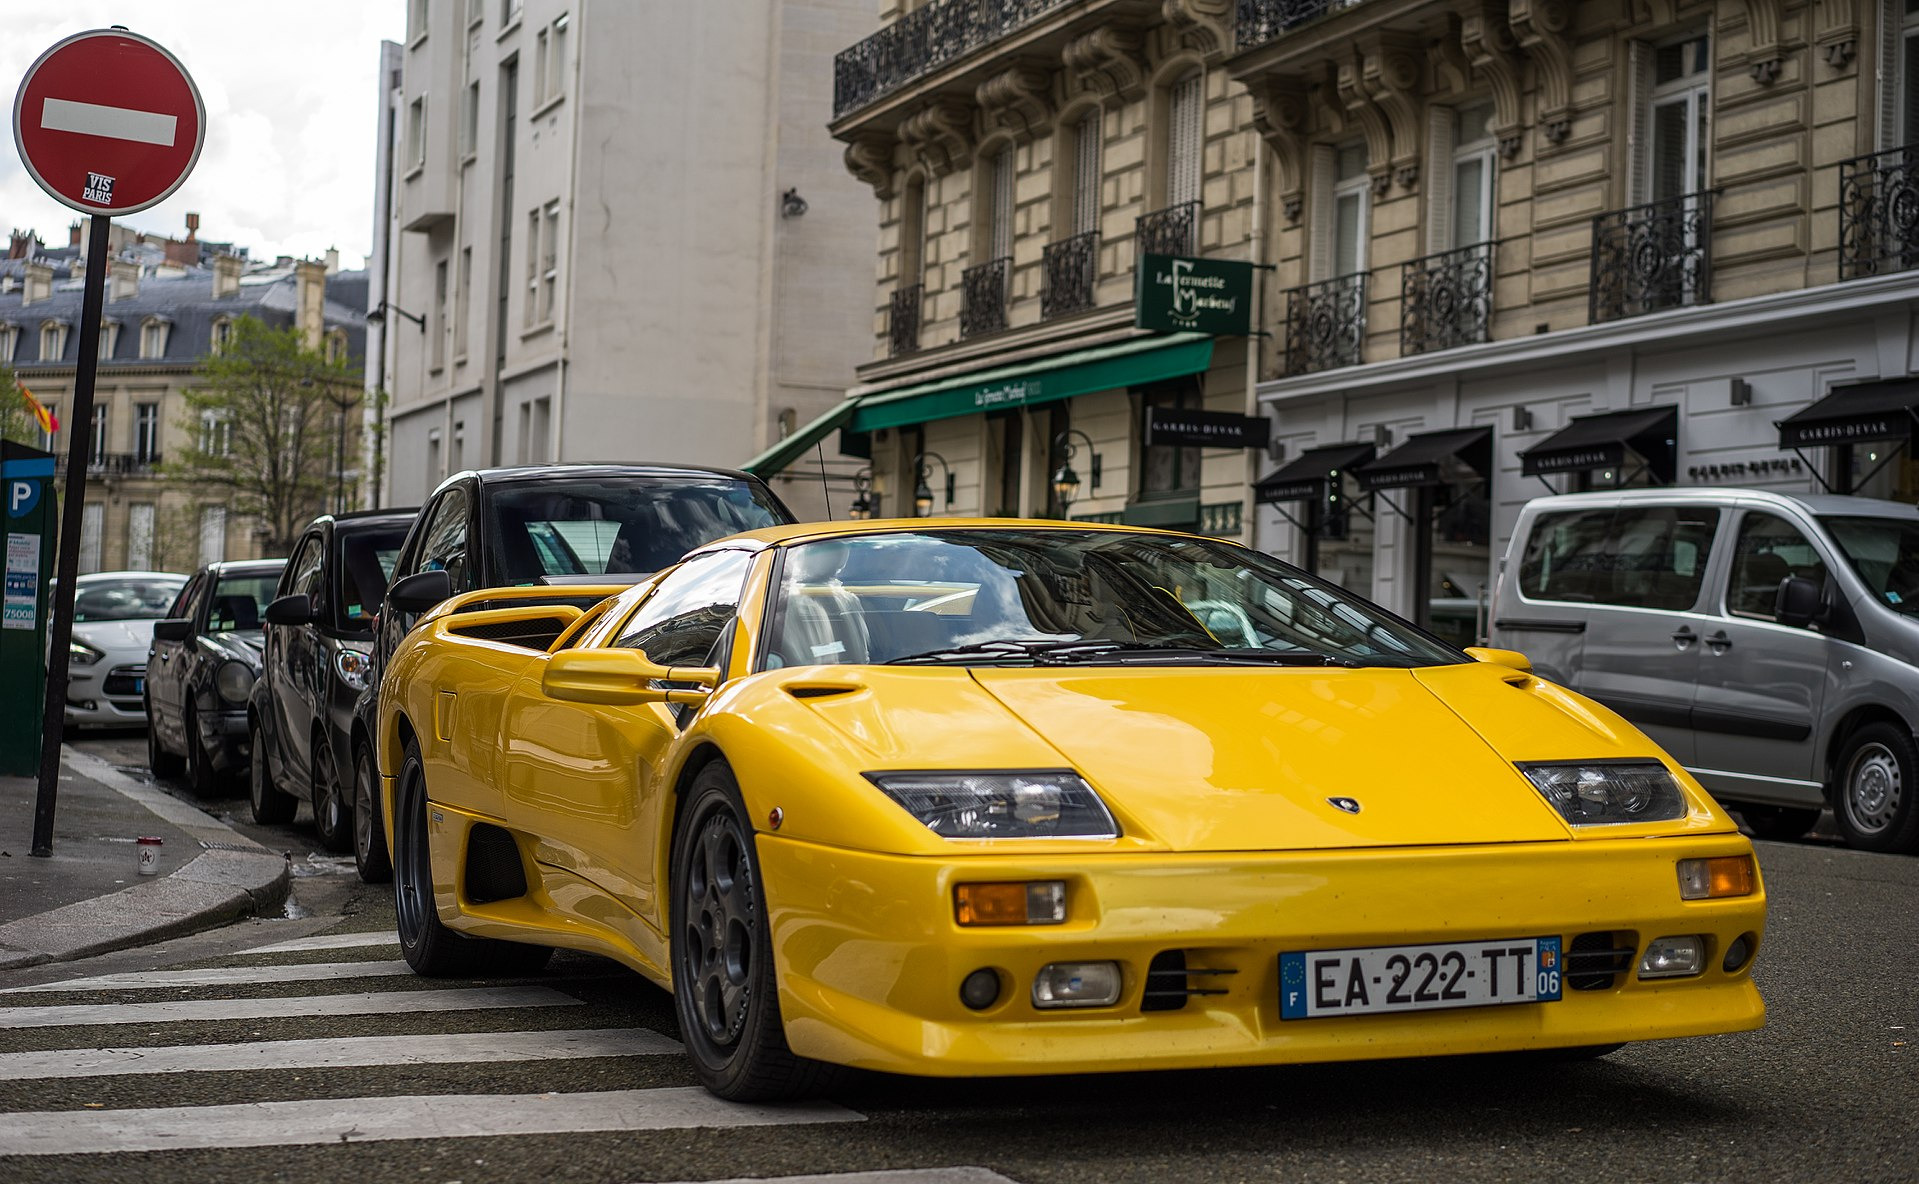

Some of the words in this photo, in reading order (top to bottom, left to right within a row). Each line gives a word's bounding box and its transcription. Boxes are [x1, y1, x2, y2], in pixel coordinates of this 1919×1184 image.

[90, 175, 111, 191] VIS
[83, 187, 112, 203] PARIS
[1156, 272, 1172, 285] La
[12, 481, 31, 511] P
[5, 609, 34, 619] 75008
[1289, 992, 1298, 1007] F
[1314, 947, 1533, 1009] EA-222-TT
[1538, 971, 1559, 995] 06
